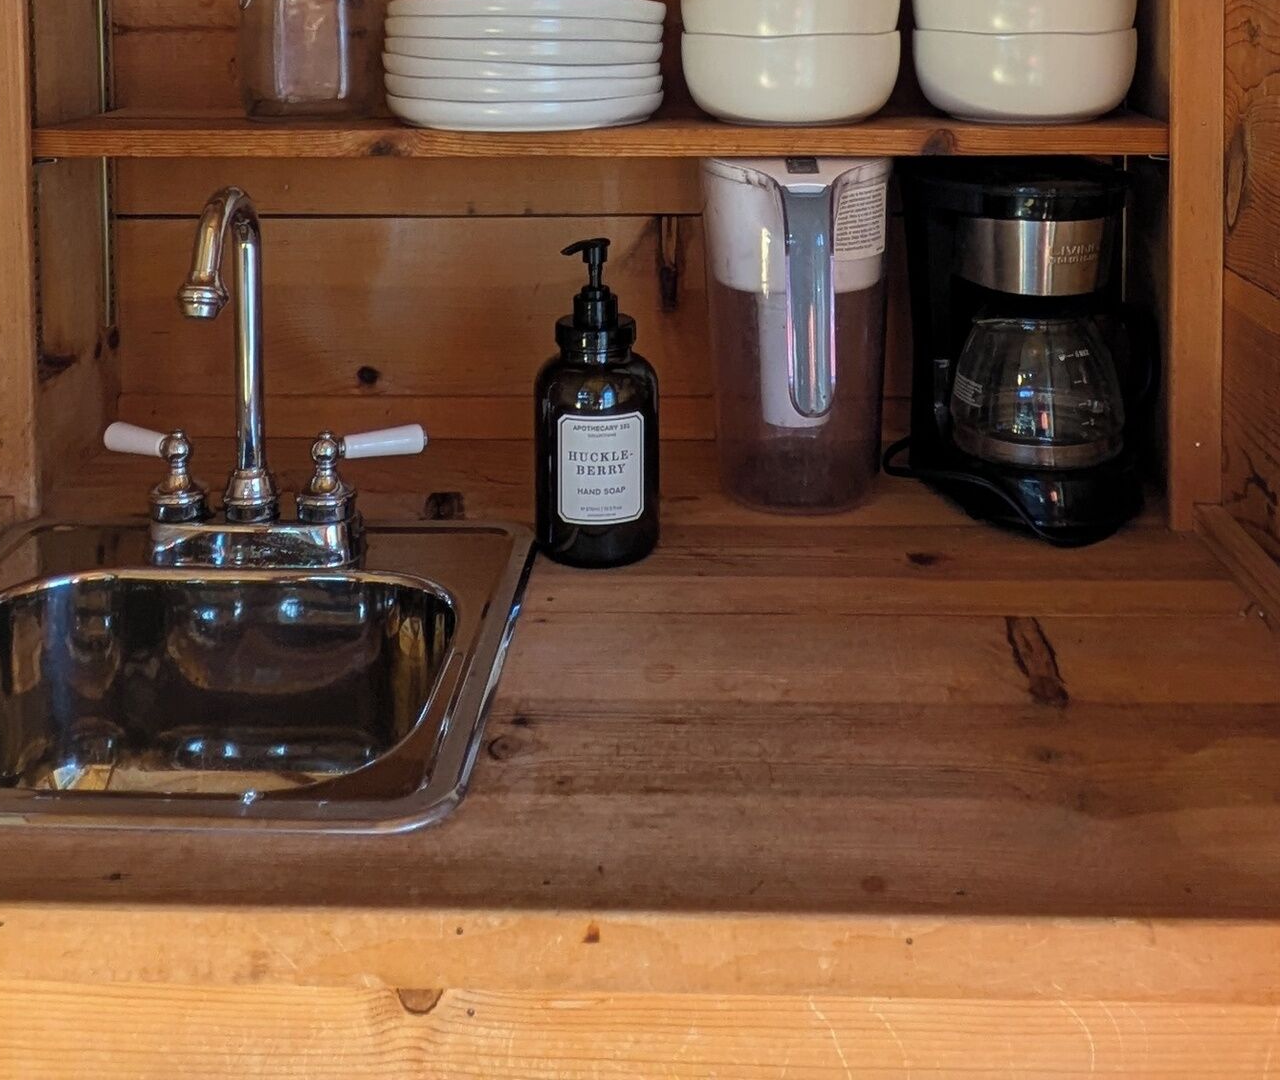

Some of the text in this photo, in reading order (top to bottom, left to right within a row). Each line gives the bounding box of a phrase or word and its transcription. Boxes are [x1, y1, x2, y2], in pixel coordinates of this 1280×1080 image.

[568, 449, 634, 463] HUCKLE-
[576, 463, 626, 476] BERRY
[577, 486, 626, 495] HAND SOAP
